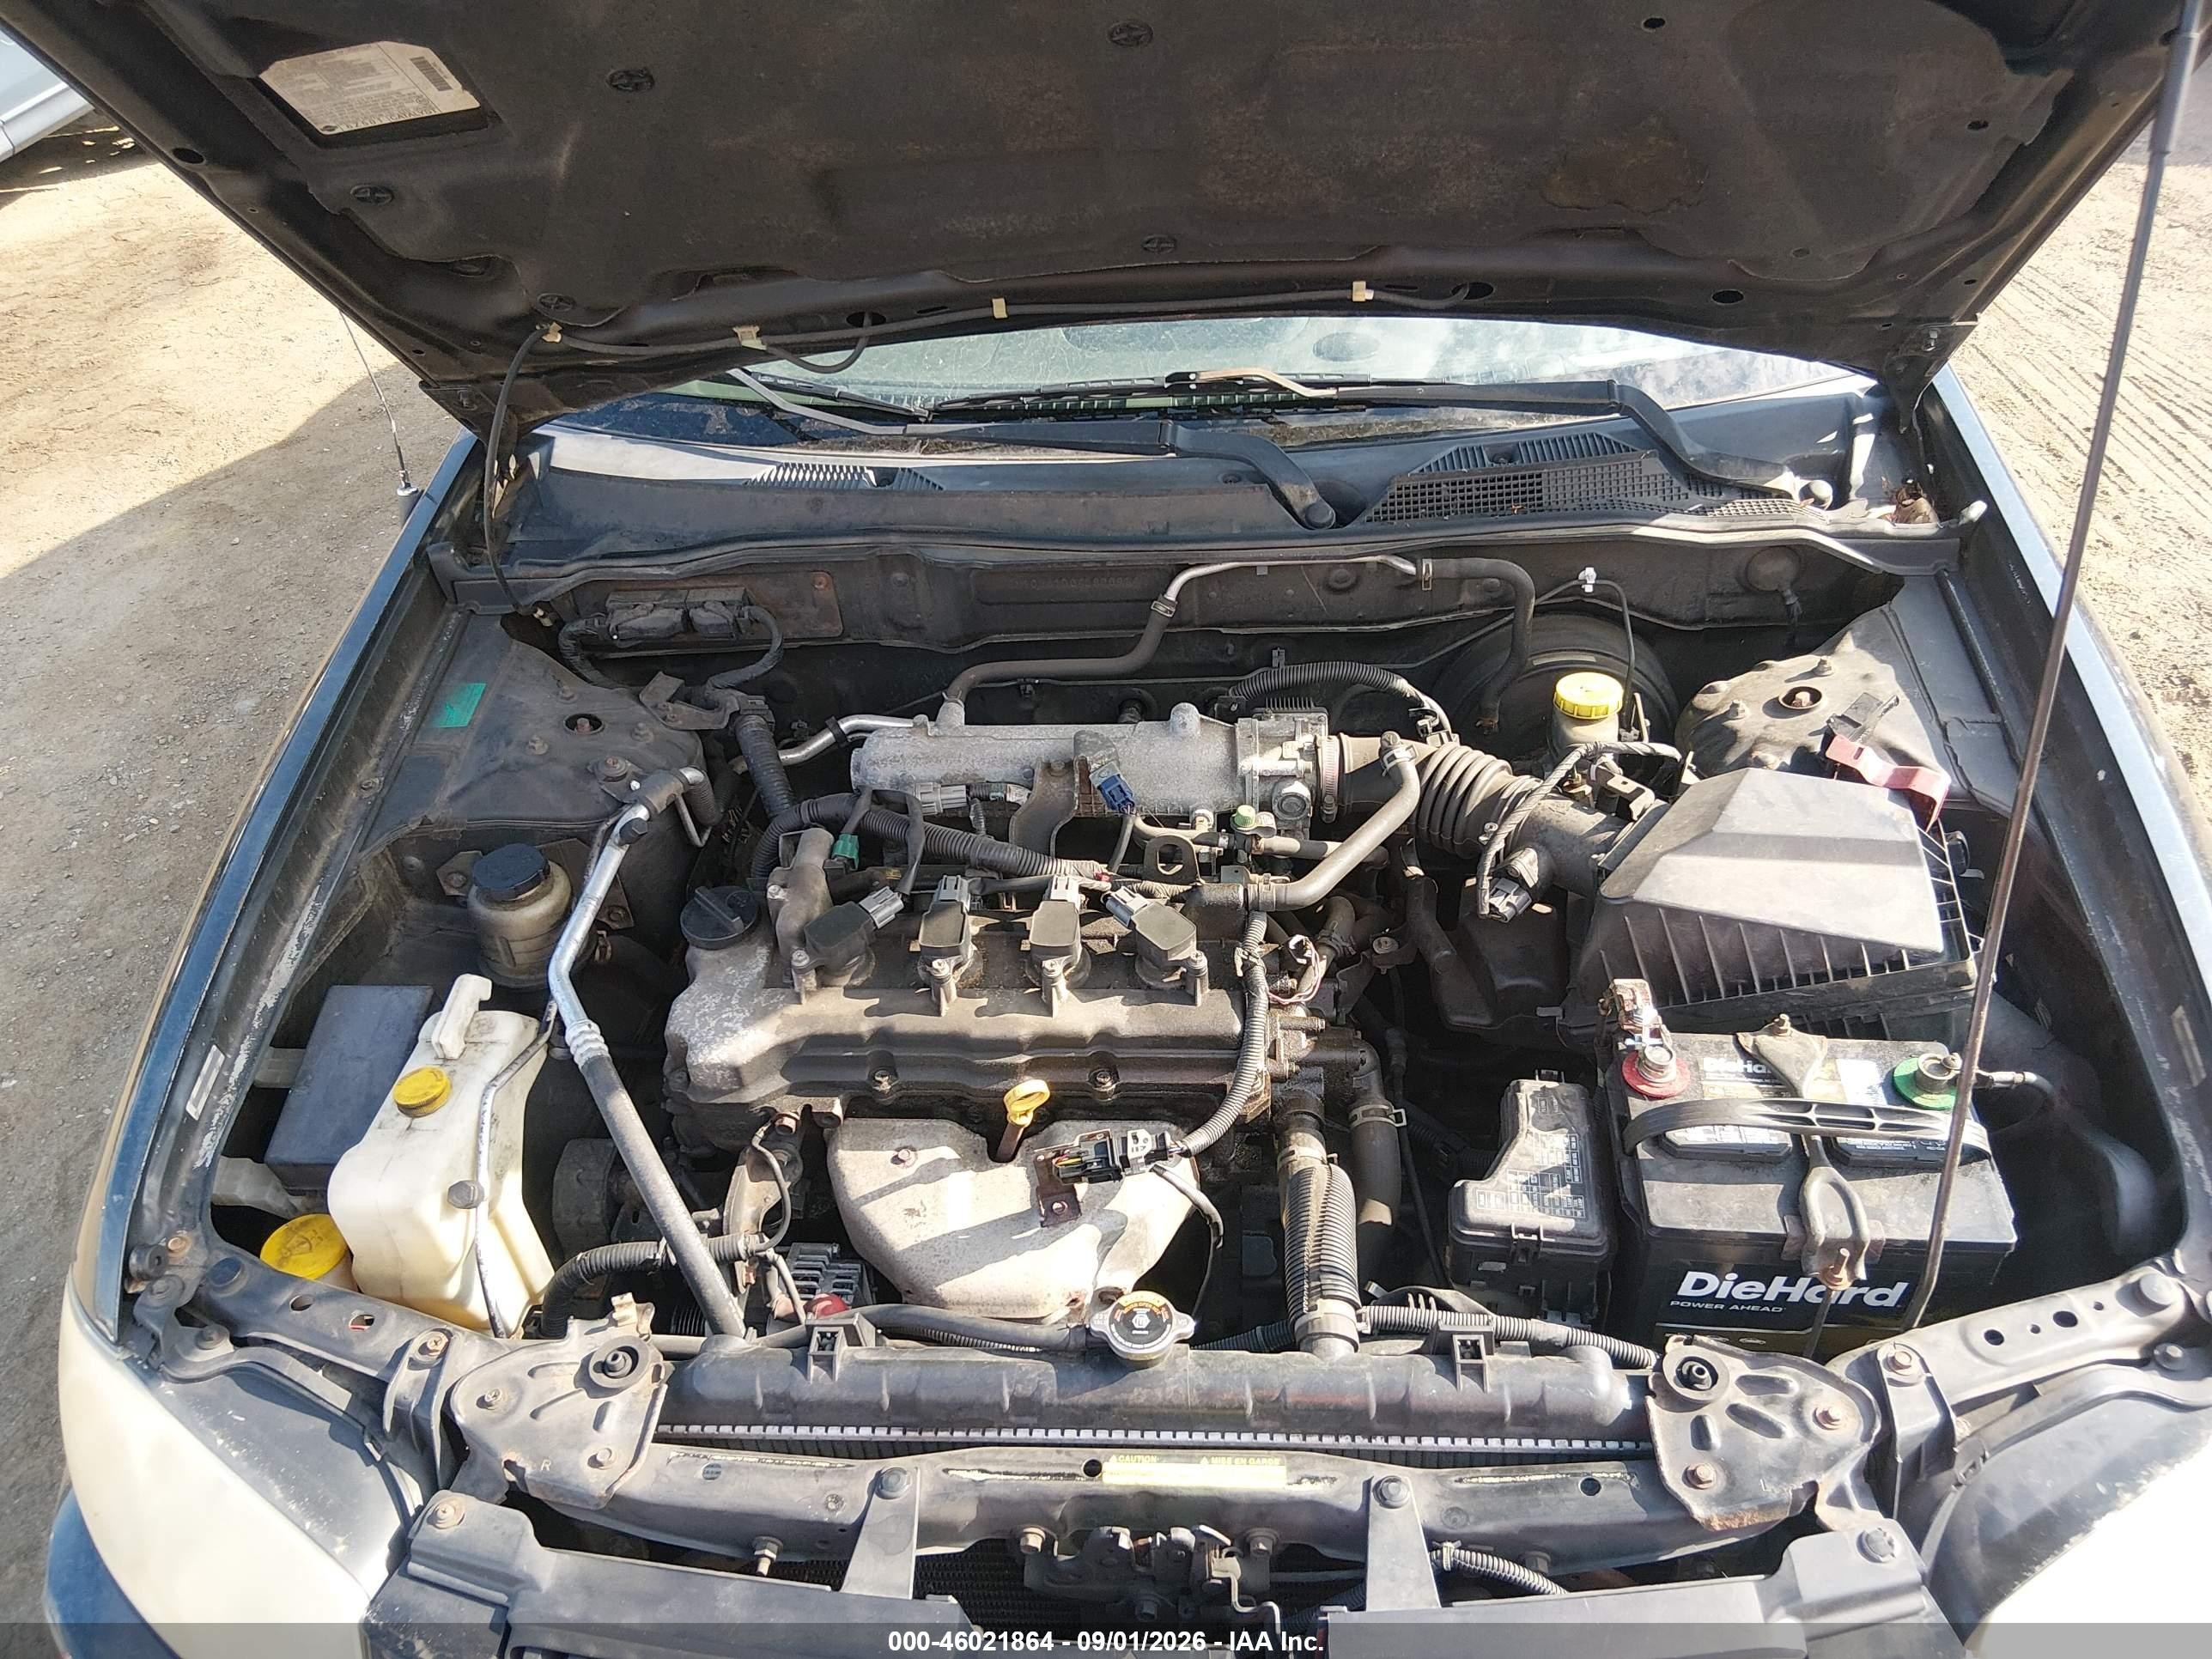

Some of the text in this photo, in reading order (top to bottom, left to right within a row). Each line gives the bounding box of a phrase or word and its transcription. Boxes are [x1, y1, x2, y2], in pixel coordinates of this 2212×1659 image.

[389, 107, 437, 121] CATALYST
[1677, 1271, 1910, 1309] DieHard
[1670, 1300, 1783, 1313] POWER AHEAD
